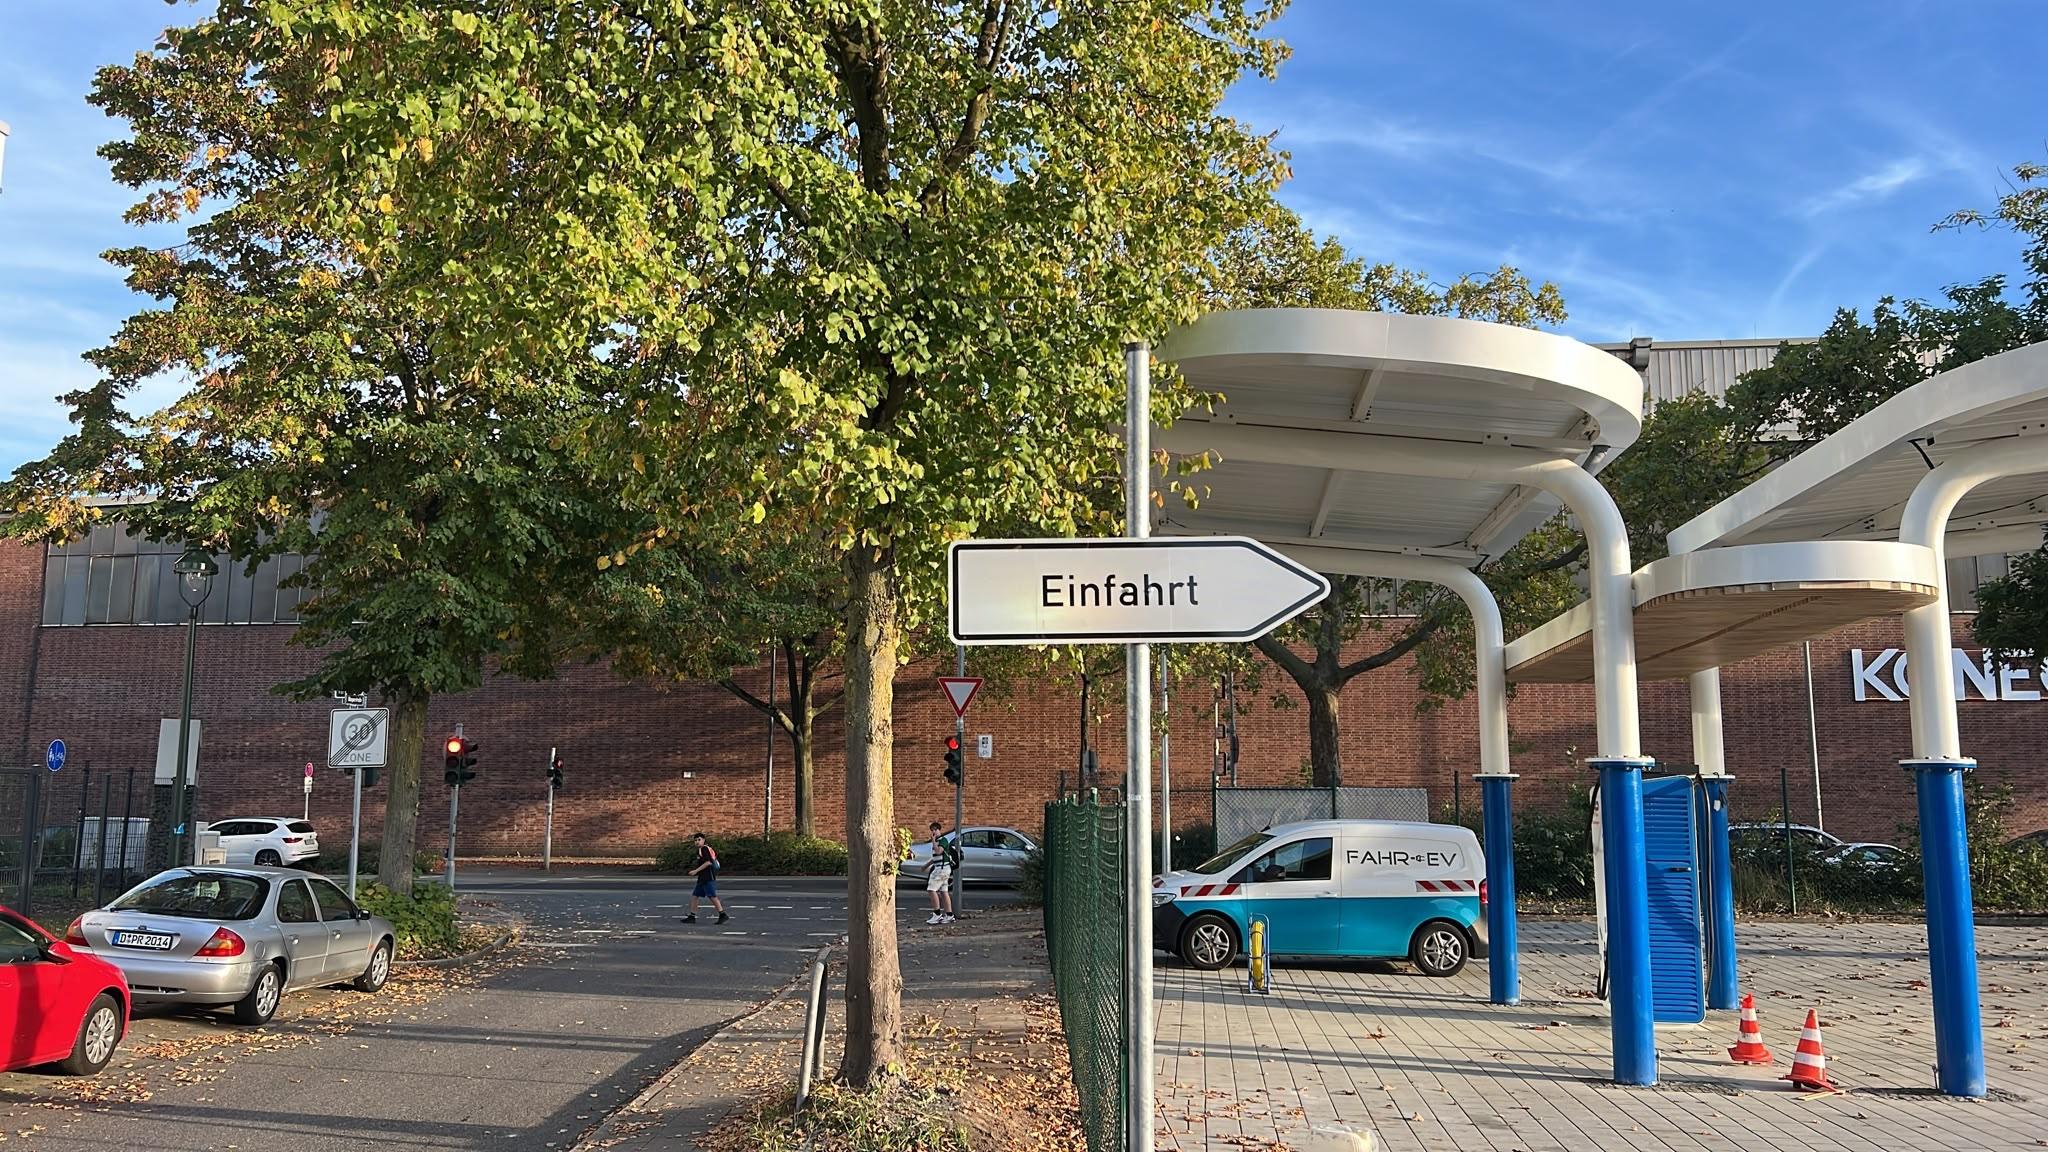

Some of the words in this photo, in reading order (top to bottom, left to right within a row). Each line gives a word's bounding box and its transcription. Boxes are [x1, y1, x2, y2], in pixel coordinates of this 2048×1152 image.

[1042, 574, 1199, 607] Einfahrt
[1851, 647, 2048, 702] KNE
[348, 723, 371, 741] 30
[343, 752, 372, 763] ZONE
[119, 933, 127, 943] D
[144, 936, 169, 947] 2014
